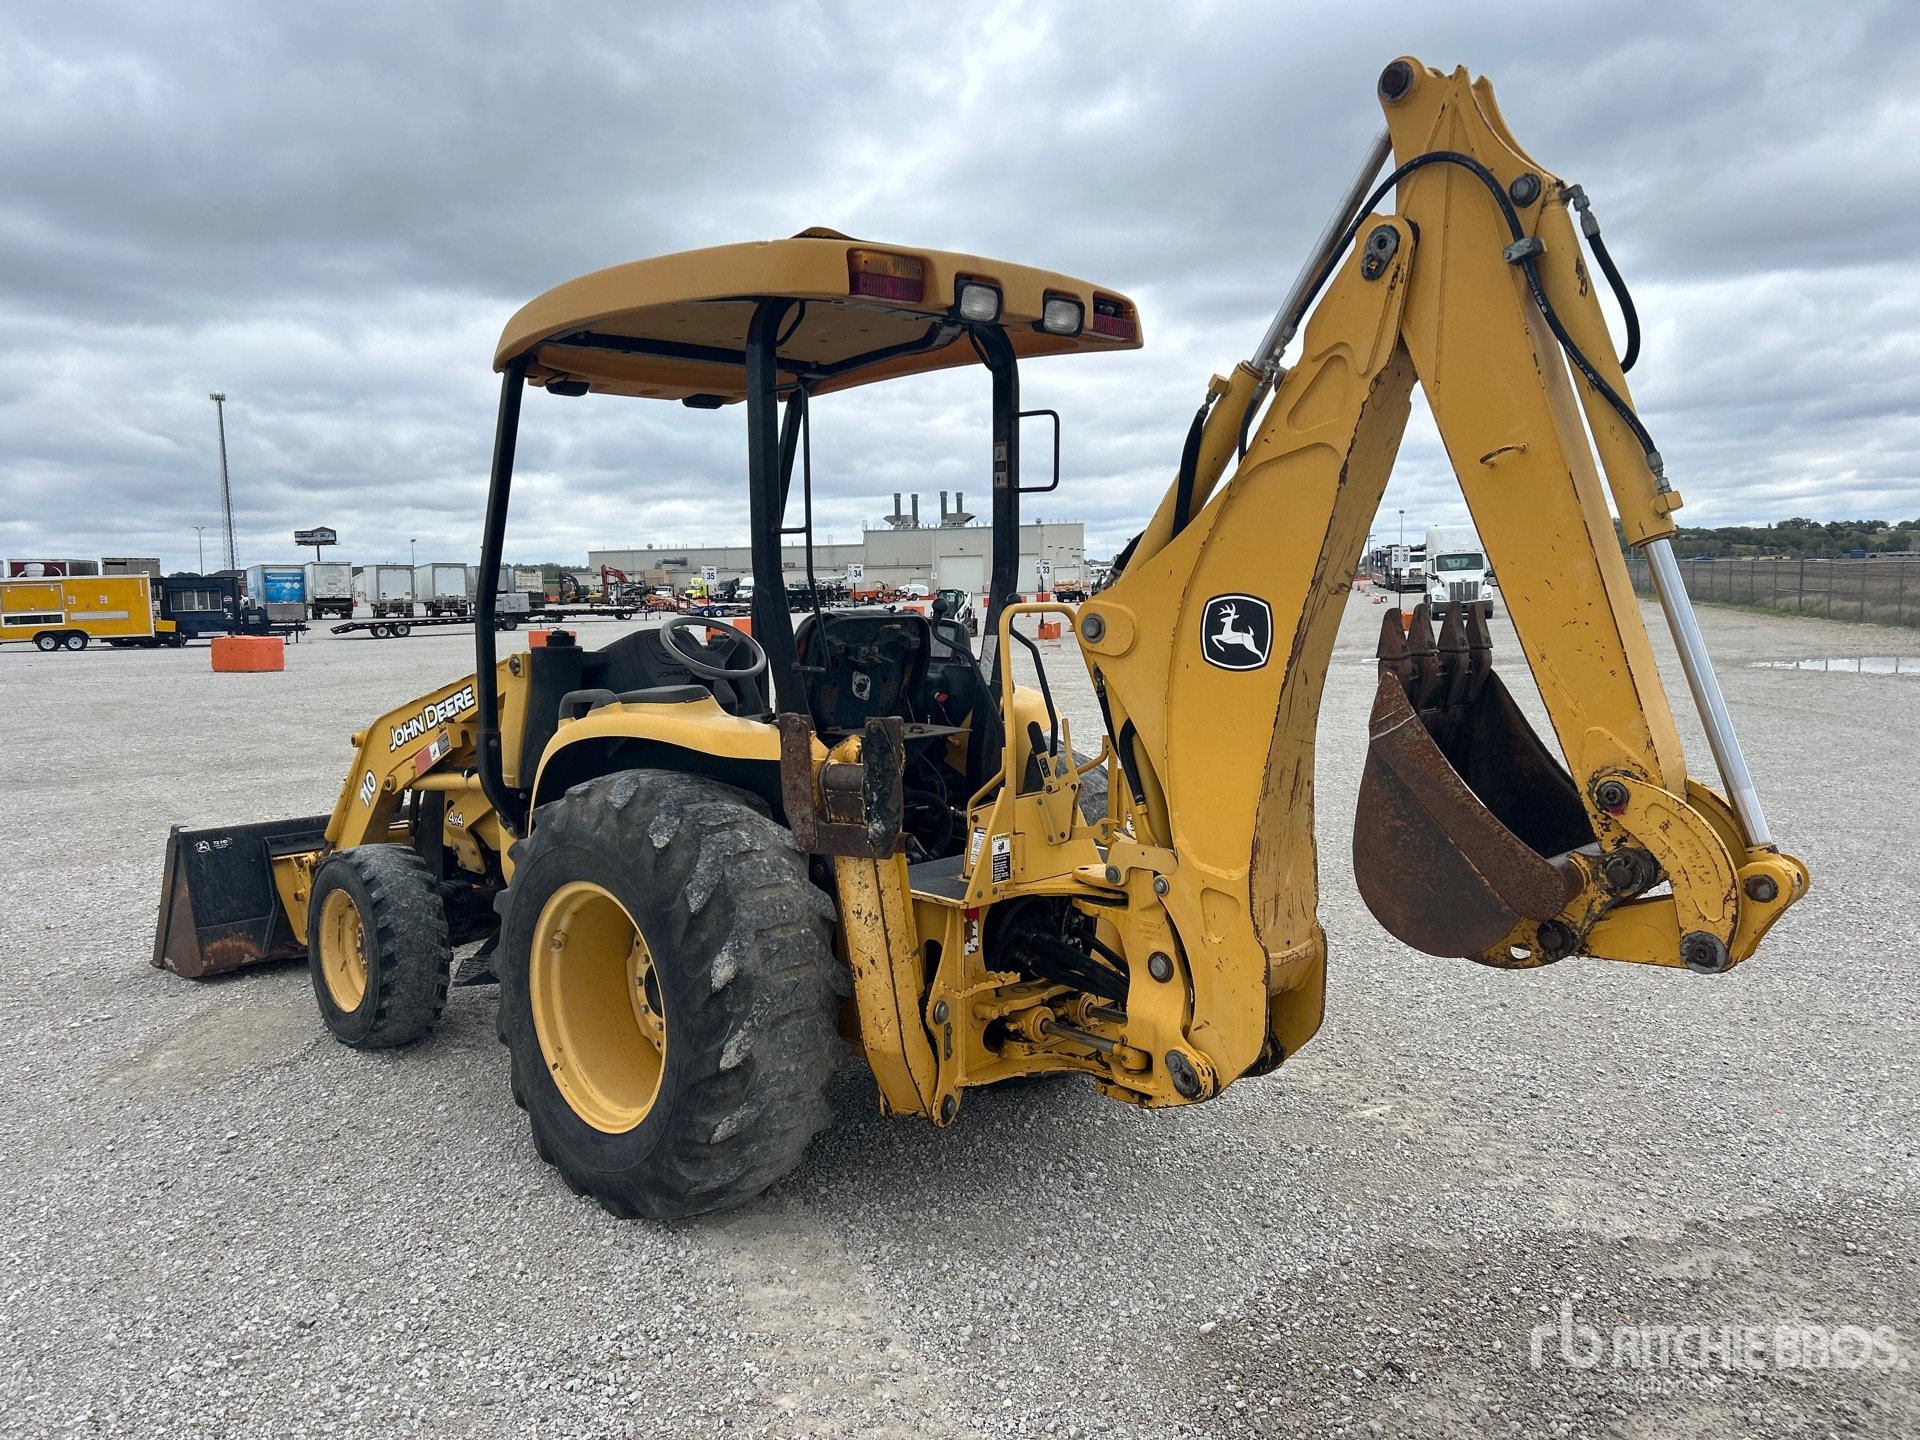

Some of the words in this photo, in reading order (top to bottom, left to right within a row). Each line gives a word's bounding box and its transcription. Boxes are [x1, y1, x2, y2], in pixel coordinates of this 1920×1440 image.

[706, 572, 715, 580] 35
[853, 569, 862, 578] 34
[1042, 565, 1050, 574] 33
[390, 713, 425, 752] JOHN
[423, 685, 475, 730] DEERE
[359, 770, 377, 808] 110
[448, 810, 464, 827] 4x4
